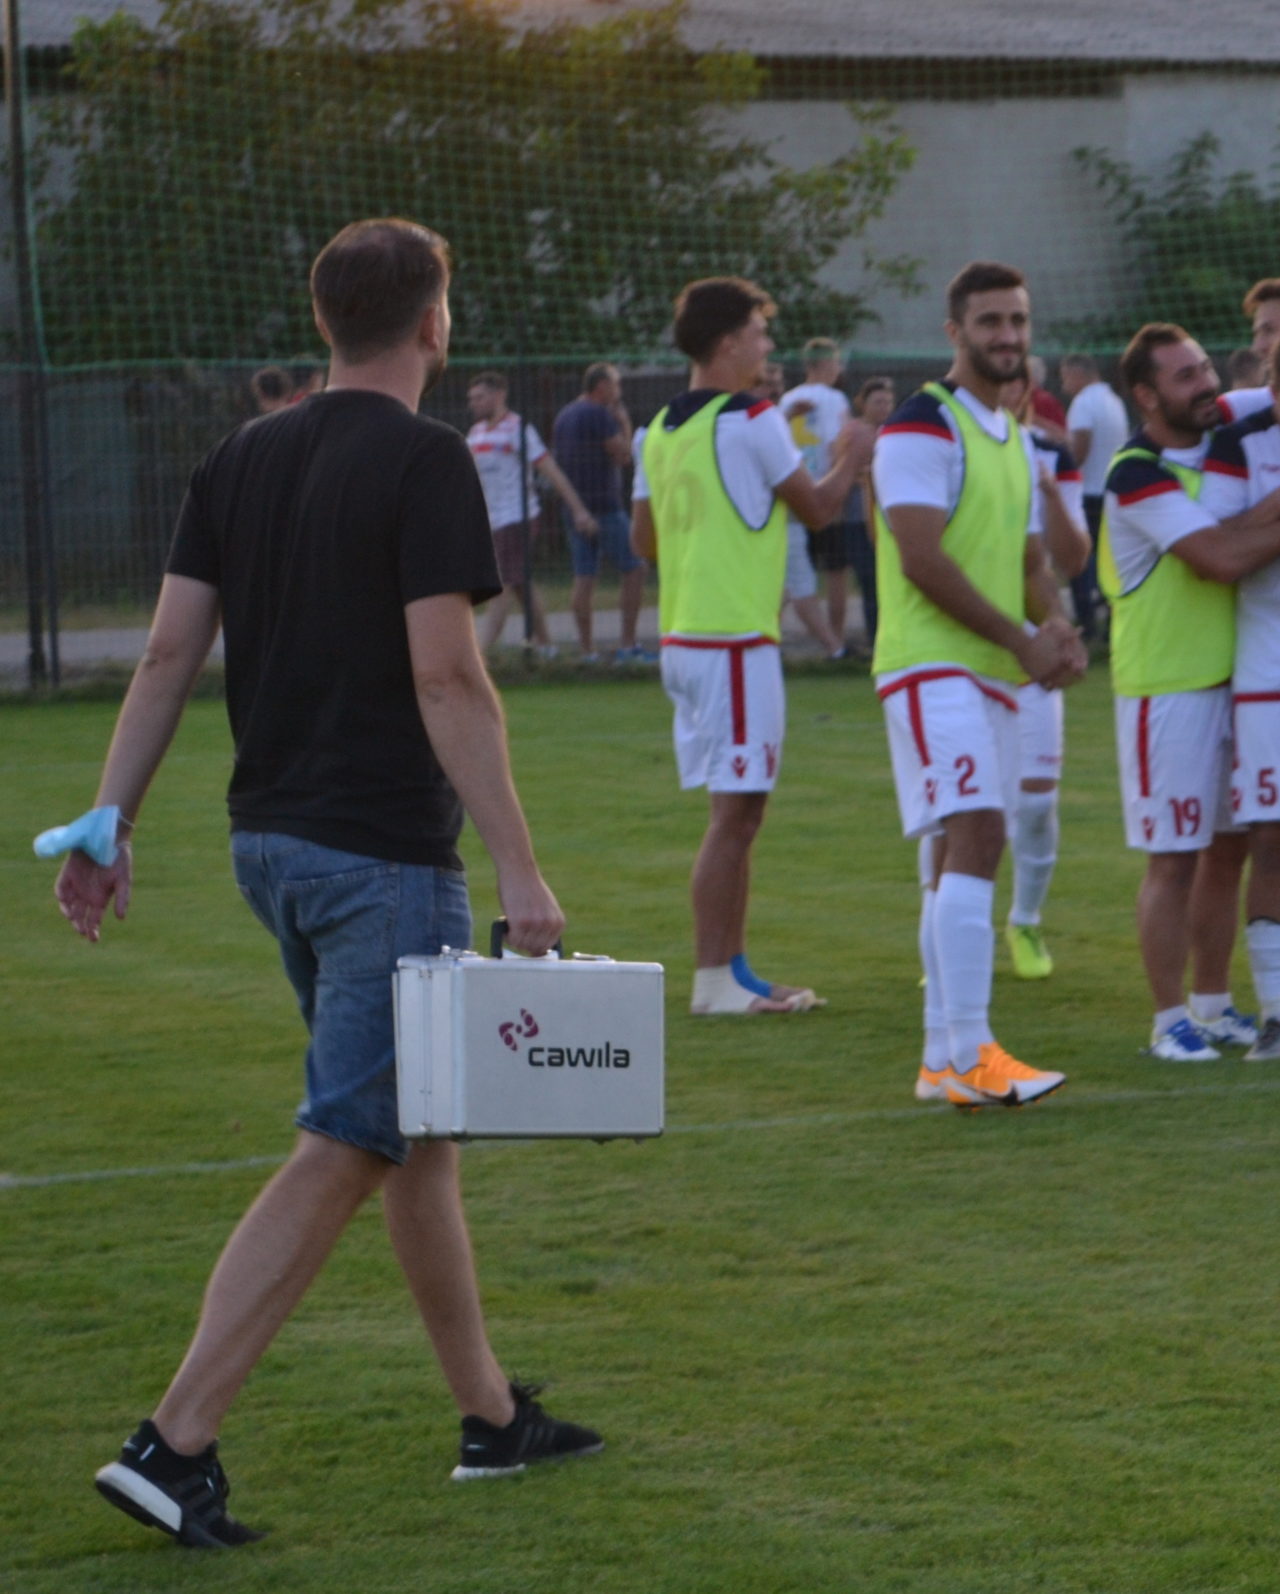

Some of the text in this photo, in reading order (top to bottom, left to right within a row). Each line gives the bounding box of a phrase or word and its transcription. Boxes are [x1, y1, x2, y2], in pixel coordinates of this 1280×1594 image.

[953, 753, 979, 796] 2
[1257, 767, 1279, 807] 5
[1168, 796, 1201, 837] 19
[527, 1041, 631, 1069] cawila
